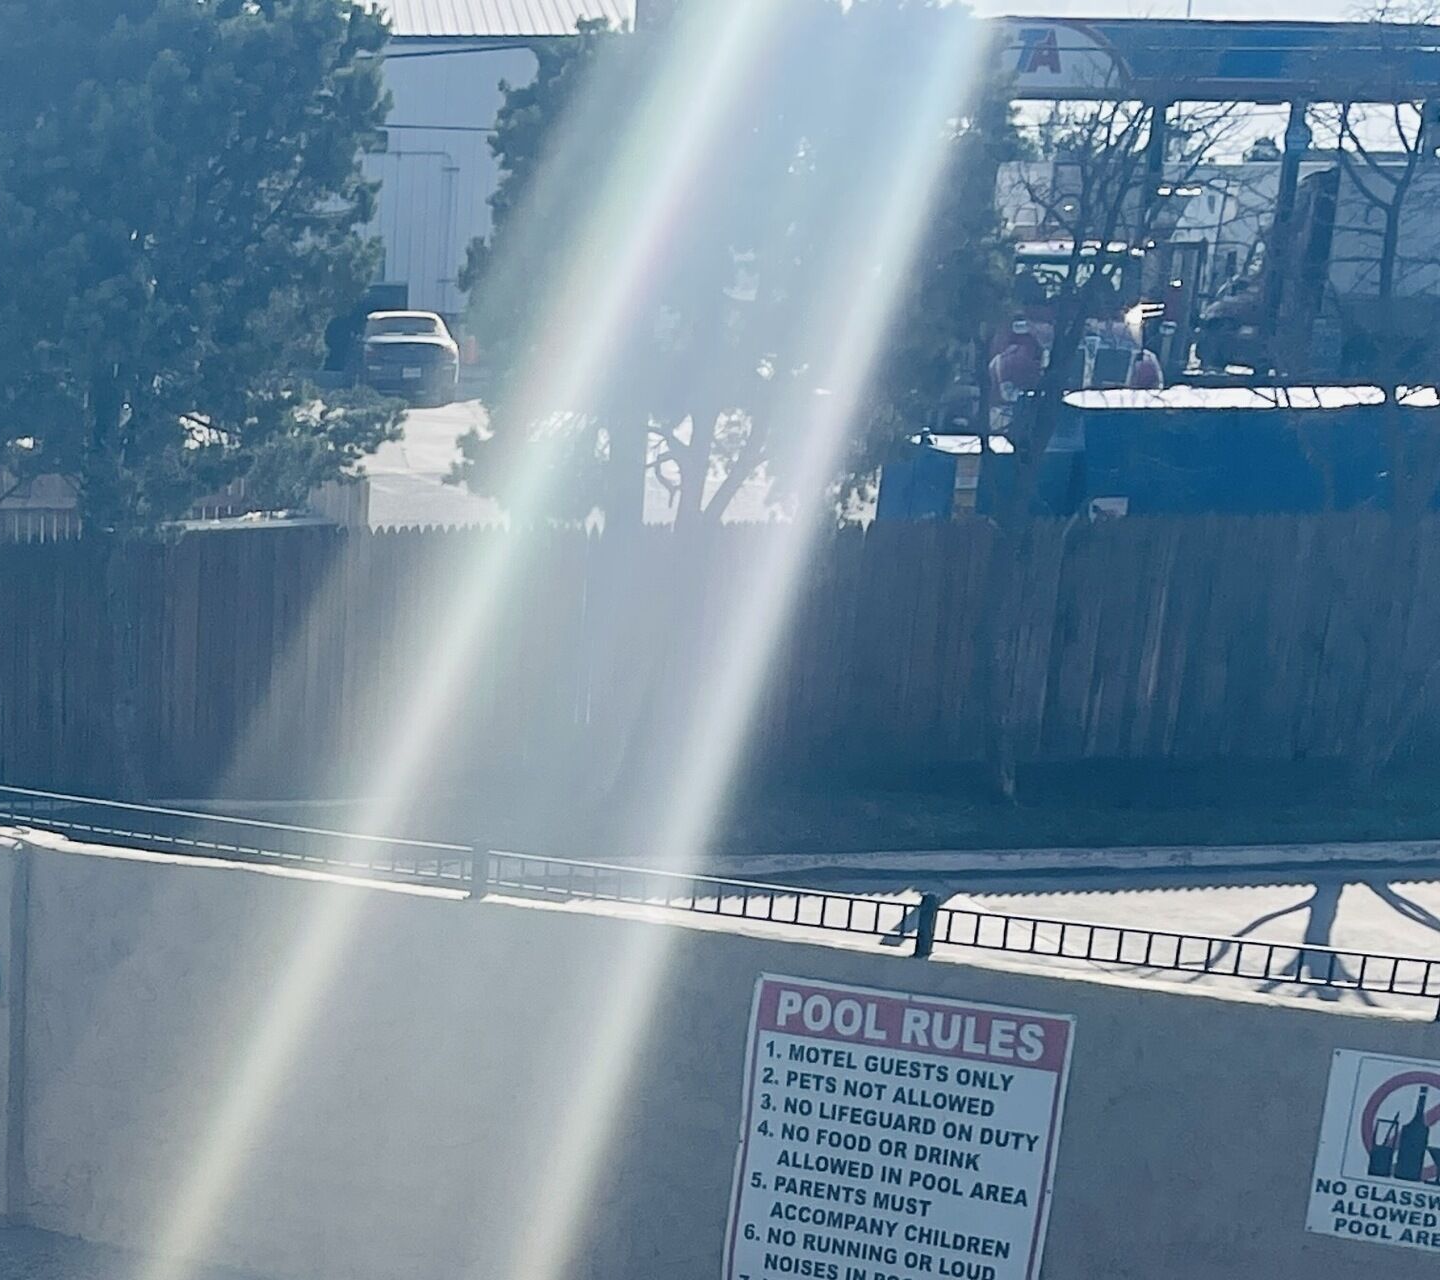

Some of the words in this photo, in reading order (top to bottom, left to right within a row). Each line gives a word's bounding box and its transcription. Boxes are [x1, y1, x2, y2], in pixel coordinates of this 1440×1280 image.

[776, 989, 887, 1041] POOL
[901, 1007, 1045, 1062] RULES
[765, 1040, 782, 1060] 1.
[788, 1043, 858, 1070] MOTEL
[864, 1055, 949, 1083] GUESTS
[956, 1068, 1015, 1093] ONLY
[762, 1067, 779, 1085] 2.
[786, 1070, 837, 1094] PETS
[843, 1079, 888, 1101] NOT
[892, 1086, 995, 1117] ALLOWED
[757, 1119, 774, 1138] 4.
[781, 1123, 810, 1142] NO
[816, 1128, 872, 1152] FOOD
[878, 1138, 908, 1159] OR
[914, 1144, 983, 1171] DRINK
[760, 1093, 777, 1112] 3.
[783, 1097, 813, 1116] NO
[818, 1102, 936, 1136] LIFEGUARD
[943, 1121, 973, 1143] ON
[979, 1127, 1040, 1152] DUTY
[750, 1171, 767, 1189] 5.
[773, 1175, 867, 1206] PARENTS
[873, 1191, 933, 1217] MUST
[776, 1149, 874, 1180] ALLOWED
[880, 1165, 903, 1185] IN
[909, 1171, 964, 1197] POOL
[969, 1181, 1029, 1207] AREA
[1315, 1178, 1347, 1196] NO
[770, 1201, 900, 1238] ACCOMPANY
[904, 1224, 1011, 1260] CHILDREN
[1331, 1200, 1437, 1228] ALLOWED
[1334, 1217, 1393, 1240] POOL
[743, 1223, 760, 1242] 6.
[766, 1227, 797, 1247] NO
[802, 1233, 898, 1265] RUNNING
[904, 1252, 933, 1272] OR
[764, 1252, 840, 1280] NOISES
